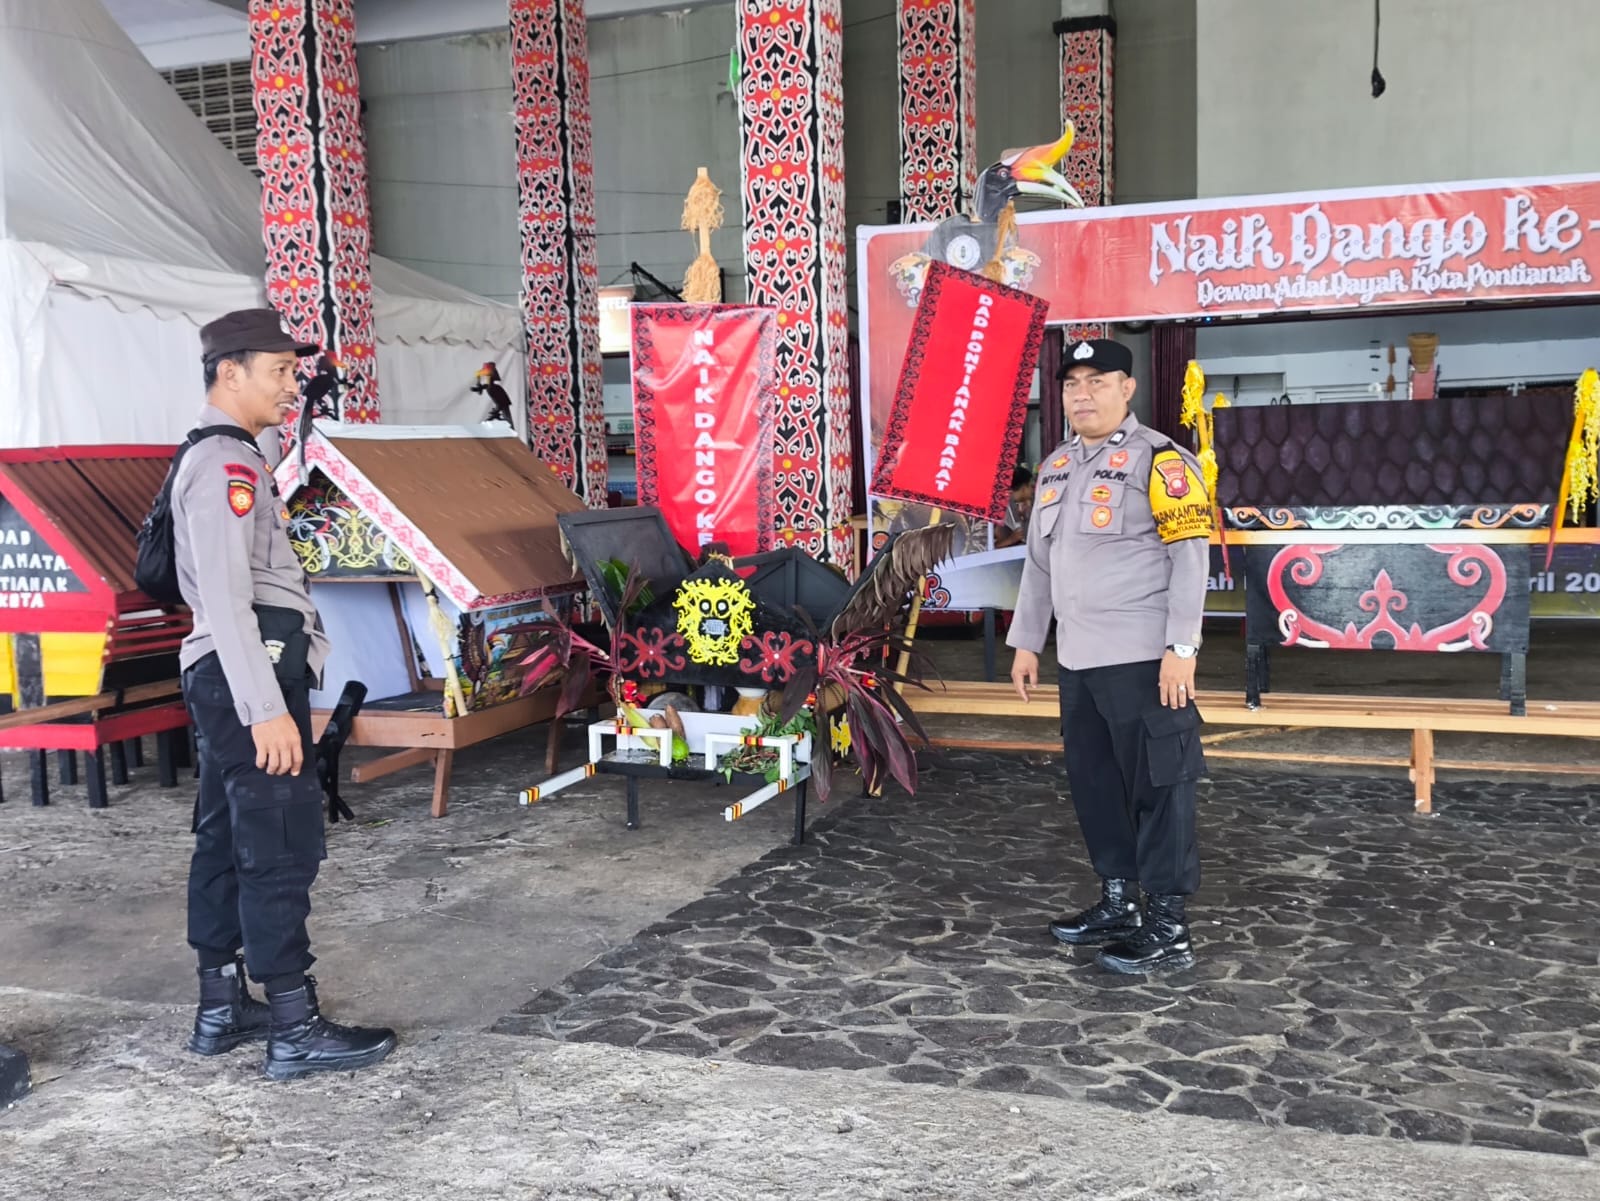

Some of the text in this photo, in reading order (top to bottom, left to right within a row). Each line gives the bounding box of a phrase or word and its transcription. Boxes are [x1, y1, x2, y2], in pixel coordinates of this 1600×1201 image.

[1149, 213, 1285, 286] Naik
[1289, 202, 1488, 272] Dango
[1197, 257, 1592, 307] Dewan Adat Dayak Kota Pontianak
[693, 330, 715, 404] NAIK
[935, 293, 994, 491] DAD PONTIANAK BARAT
[694, 413, 717, 505] DANGO
[1093, 470, 1128, 482] POLRI
